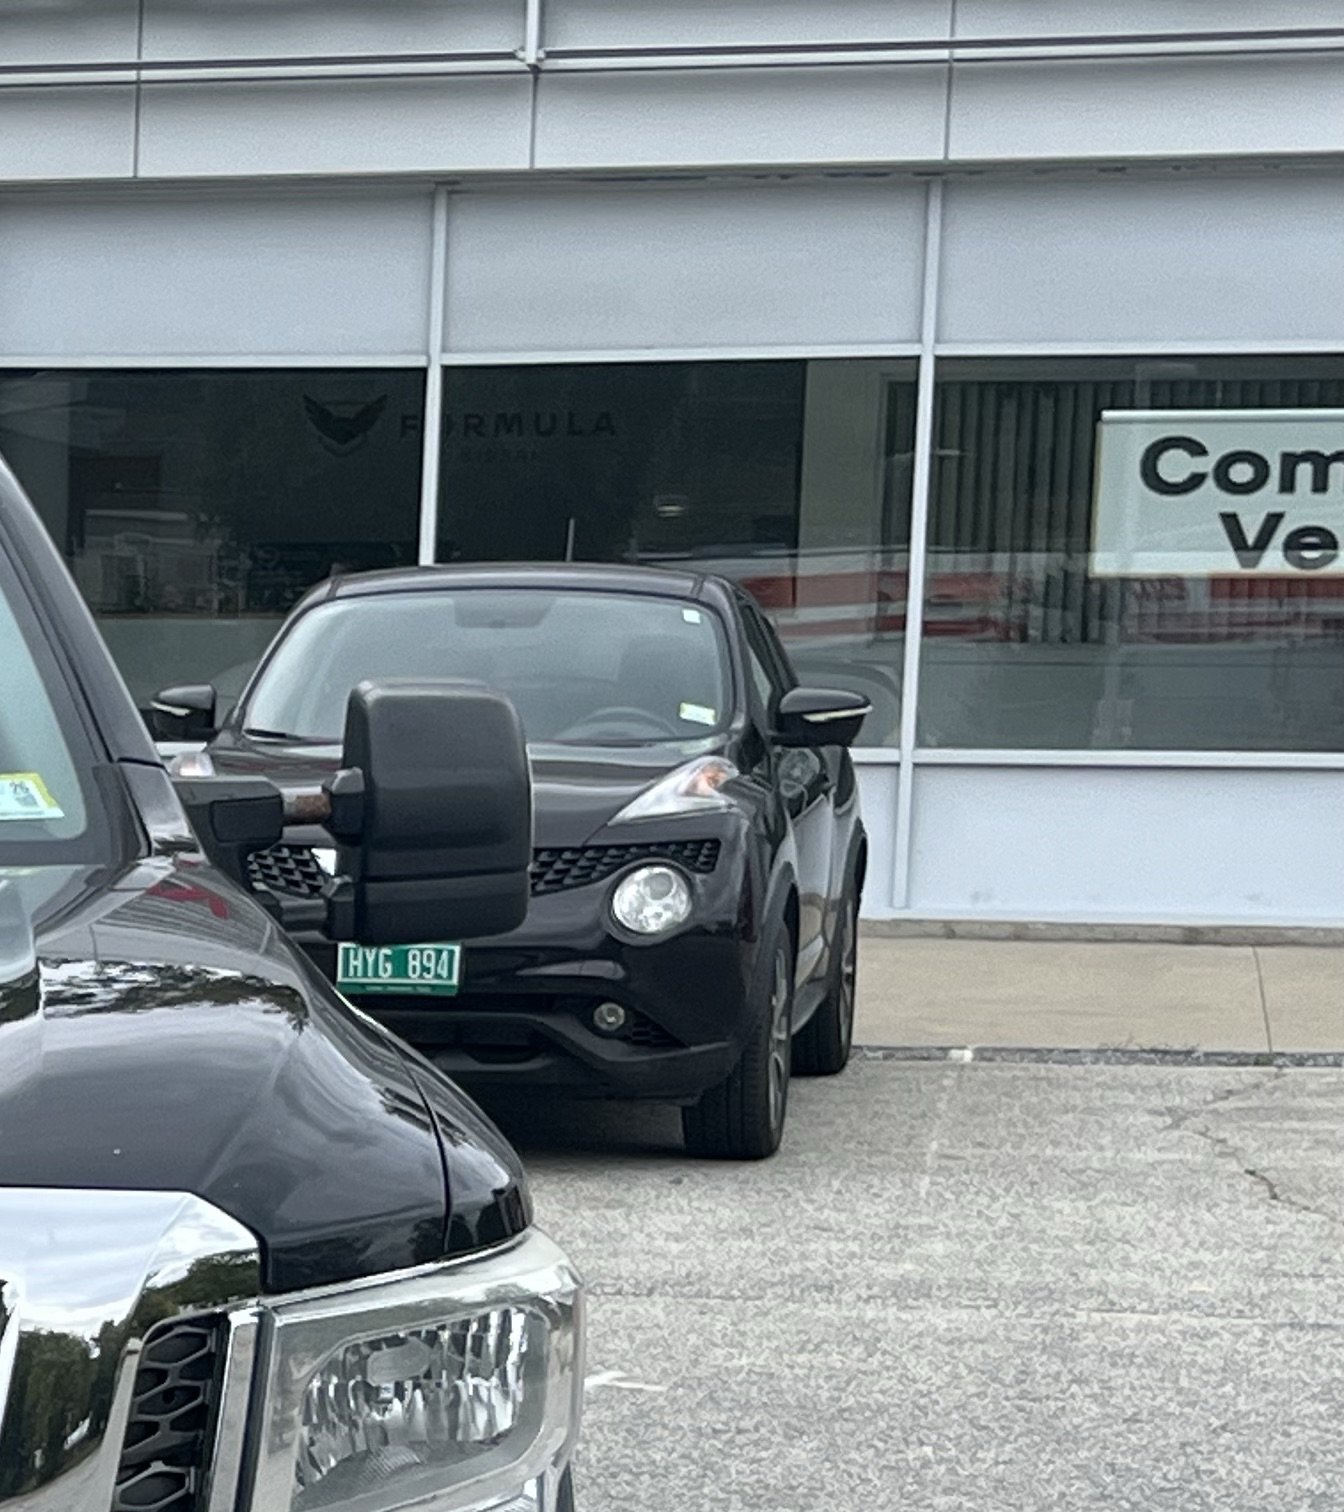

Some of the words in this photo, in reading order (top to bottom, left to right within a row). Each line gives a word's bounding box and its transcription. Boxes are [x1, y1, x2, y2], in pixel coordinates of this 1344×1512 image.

[399, 411, 616, 438] FRMULA
[1140, 435, 1344, 496] Com
[1219, 511, 1339, 570] Ve
[348, 947, 392, 978] HYG
[407, 948, 449, 979] 894
